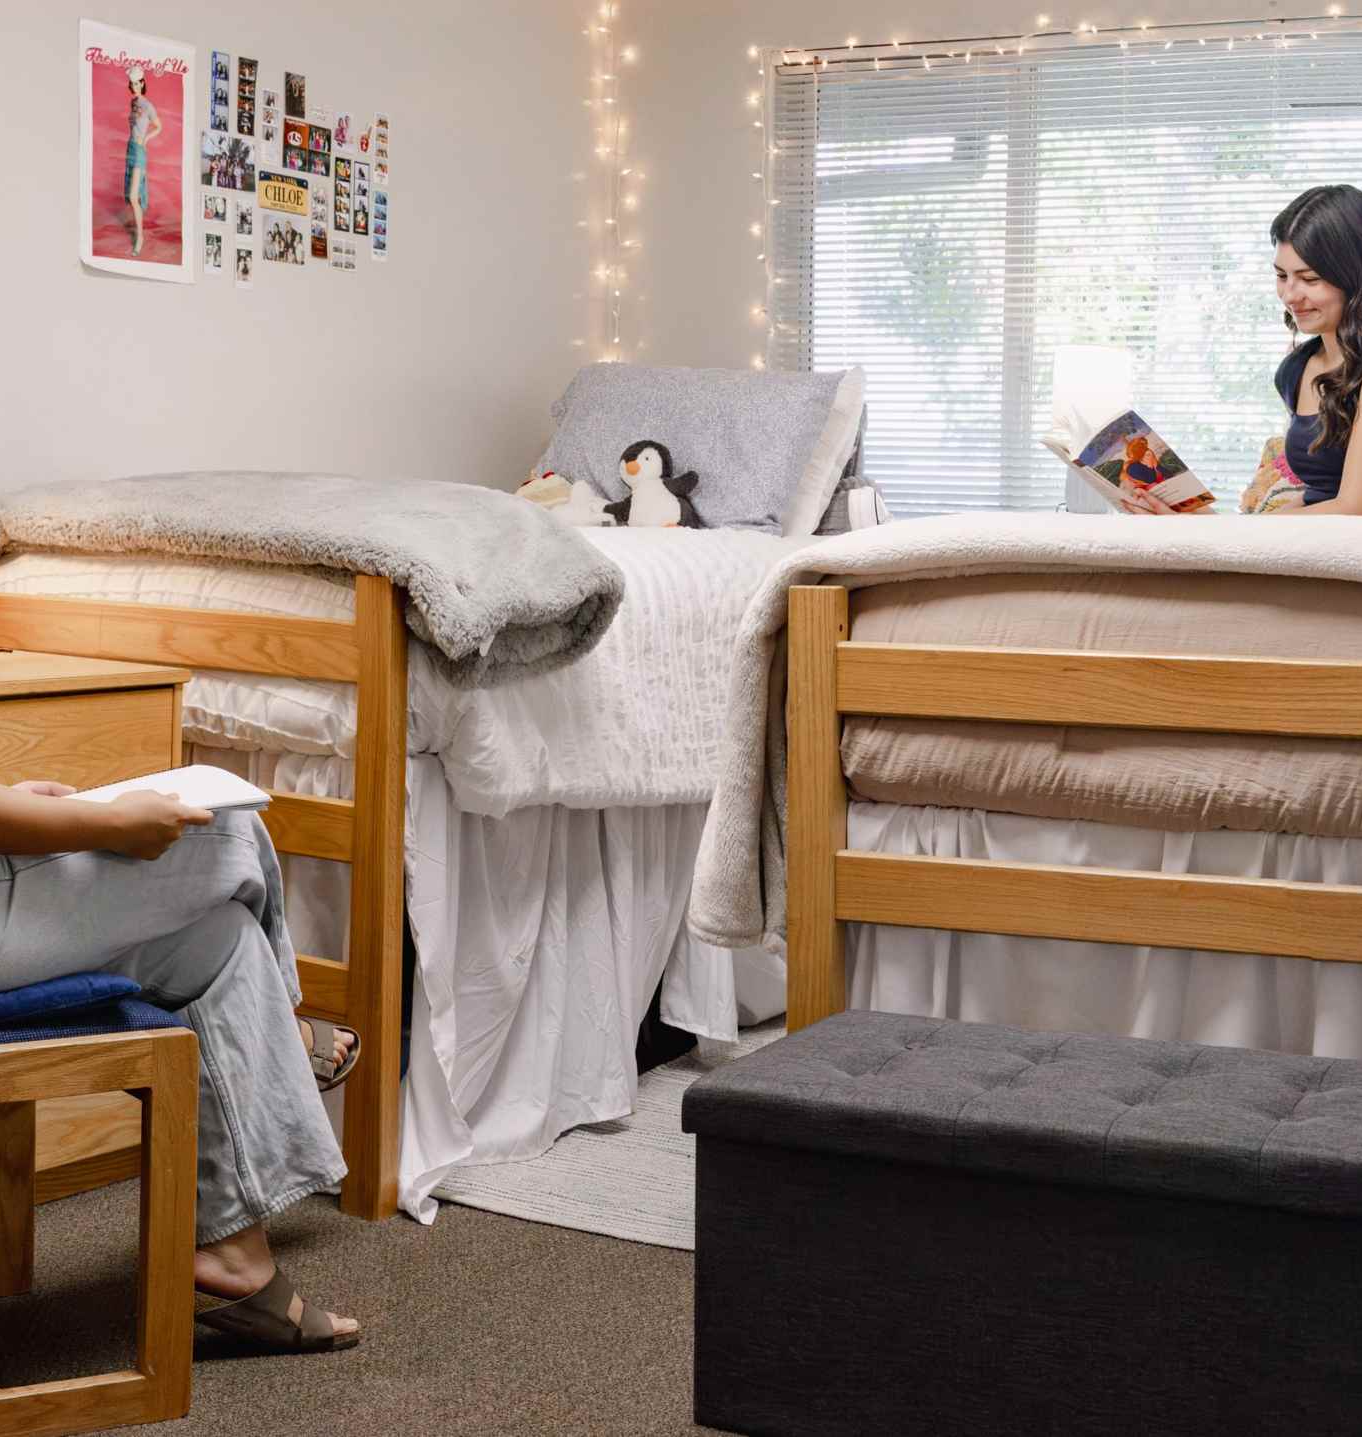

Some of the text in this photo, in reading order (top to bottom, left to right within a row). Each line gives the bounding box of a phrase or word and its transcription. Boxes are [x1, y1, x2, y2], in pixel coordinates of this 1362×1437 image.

[85, 46, 110, 65] The
[111, 50, 153, 70] Secret
[169, 56, 189, 74] Us
[264, 184, 304, 207] CHLOE
